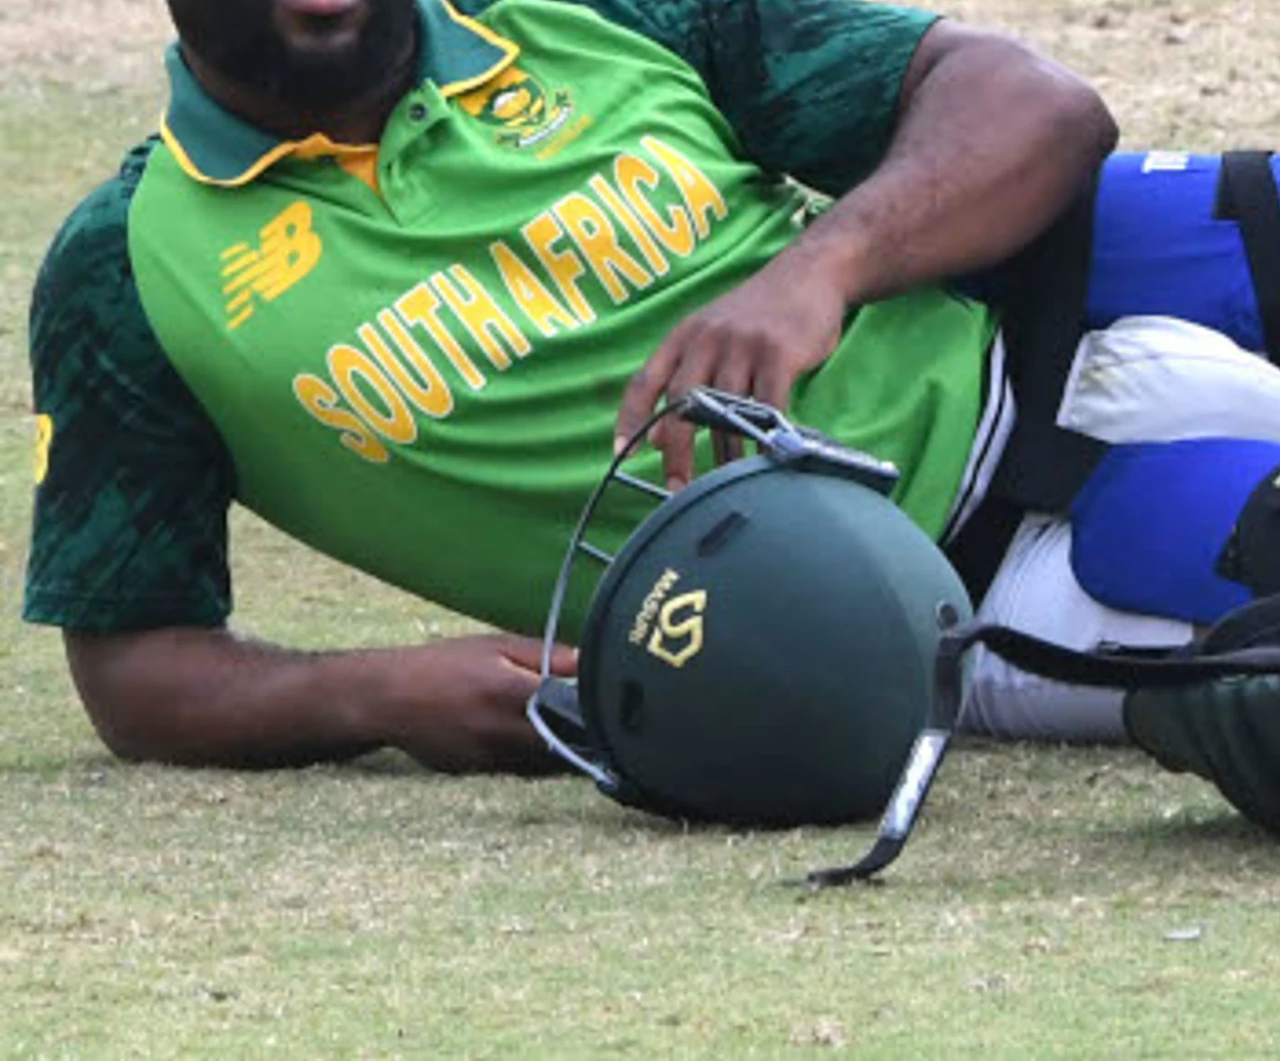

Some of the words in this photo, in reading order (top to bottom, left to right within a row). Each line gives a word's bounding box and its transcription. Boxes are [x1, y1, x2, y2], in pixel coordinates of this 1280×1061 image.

[219, 201, 323, 330] NB
[292, 263, 532, 463] SOUTH
[489, 135, 729, 338] AFRICA
